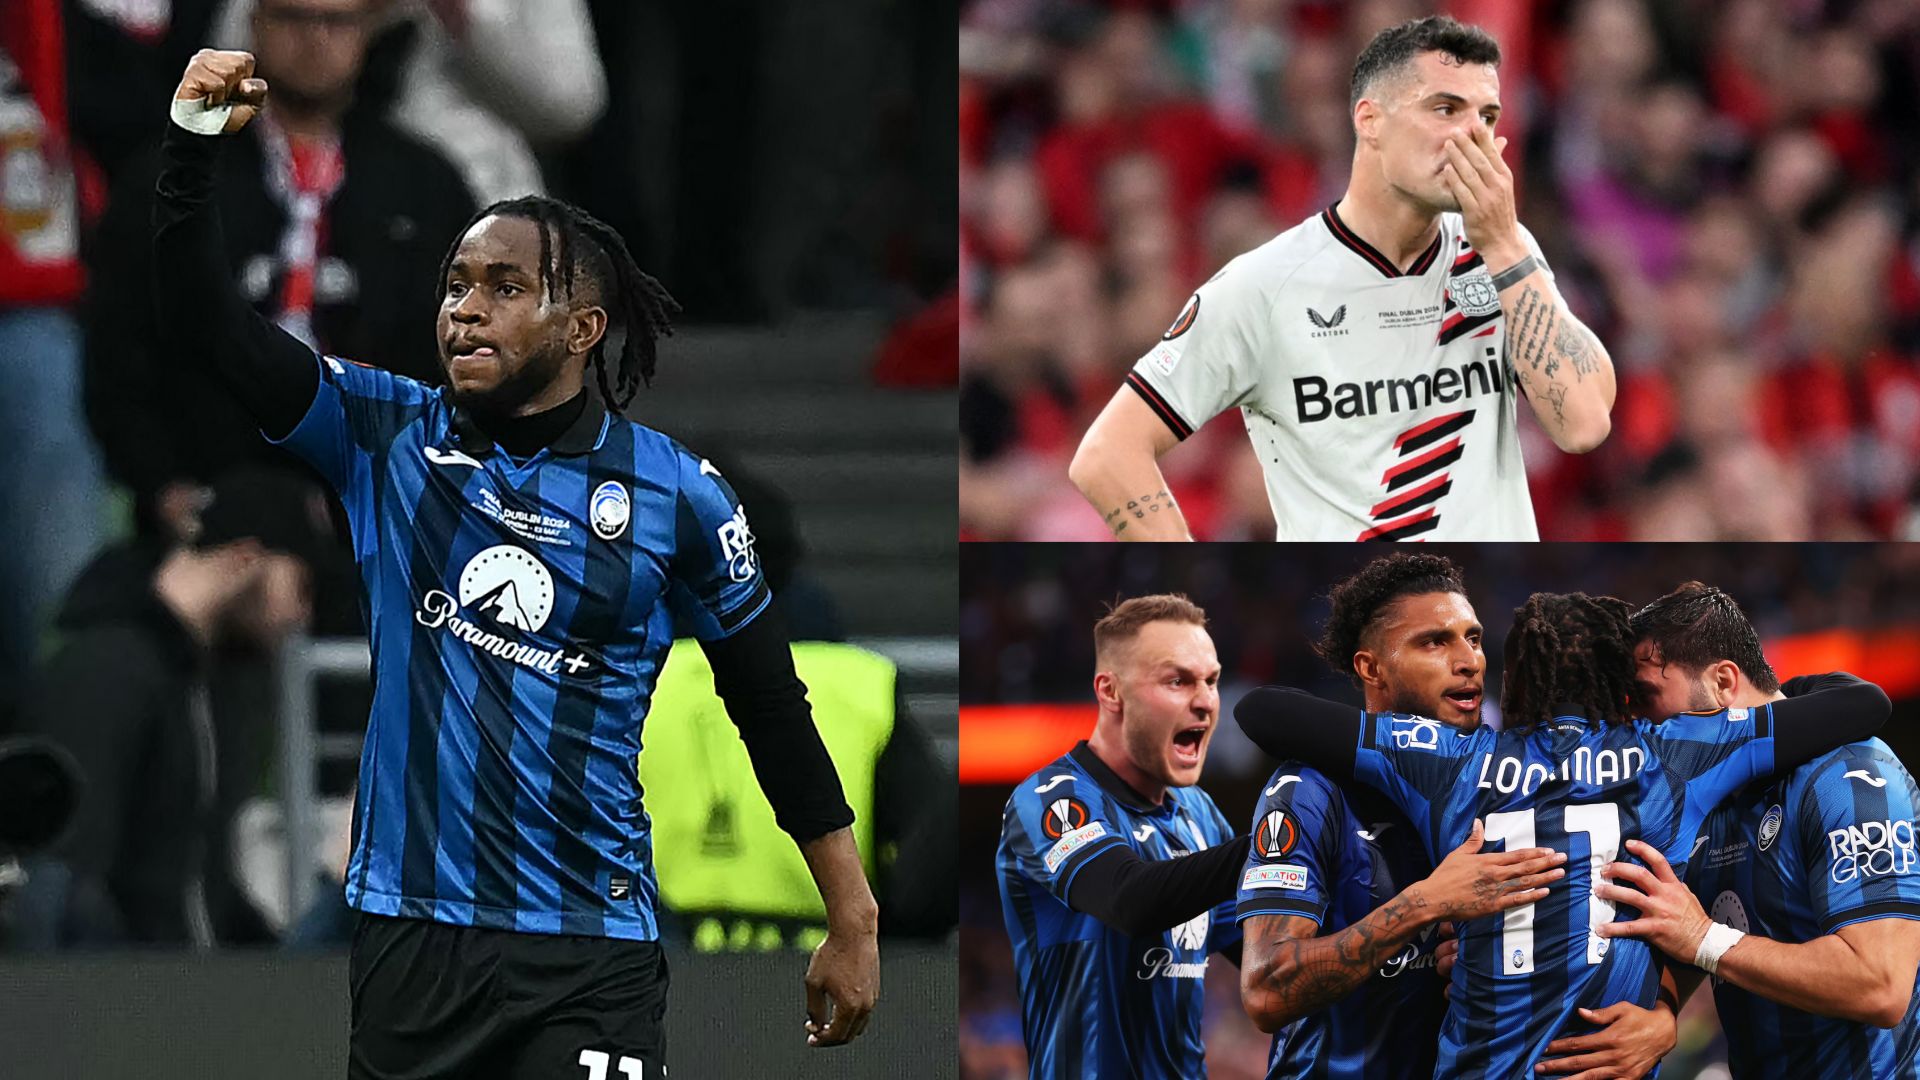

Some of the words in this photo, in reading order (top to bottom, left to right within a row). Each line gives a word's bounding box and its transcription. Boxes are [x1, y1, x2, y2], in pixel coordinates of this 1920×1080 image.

[1311, 329, 1350, 338] CASTORE
[1292, 346, 1504, 424] Barmeni
[503, 508, 542, 525] DUBLIN
[541, 516, 571, 529] 2024
[415, 589, 590, 675] Paramount+
[1828, 819, 1915, 860] RADICI
[1245, 871, 1305, 881] FOUNDATION
[1832, 848, 1917, 884] GROUP
[1484, 802, 1621, 976] 11
